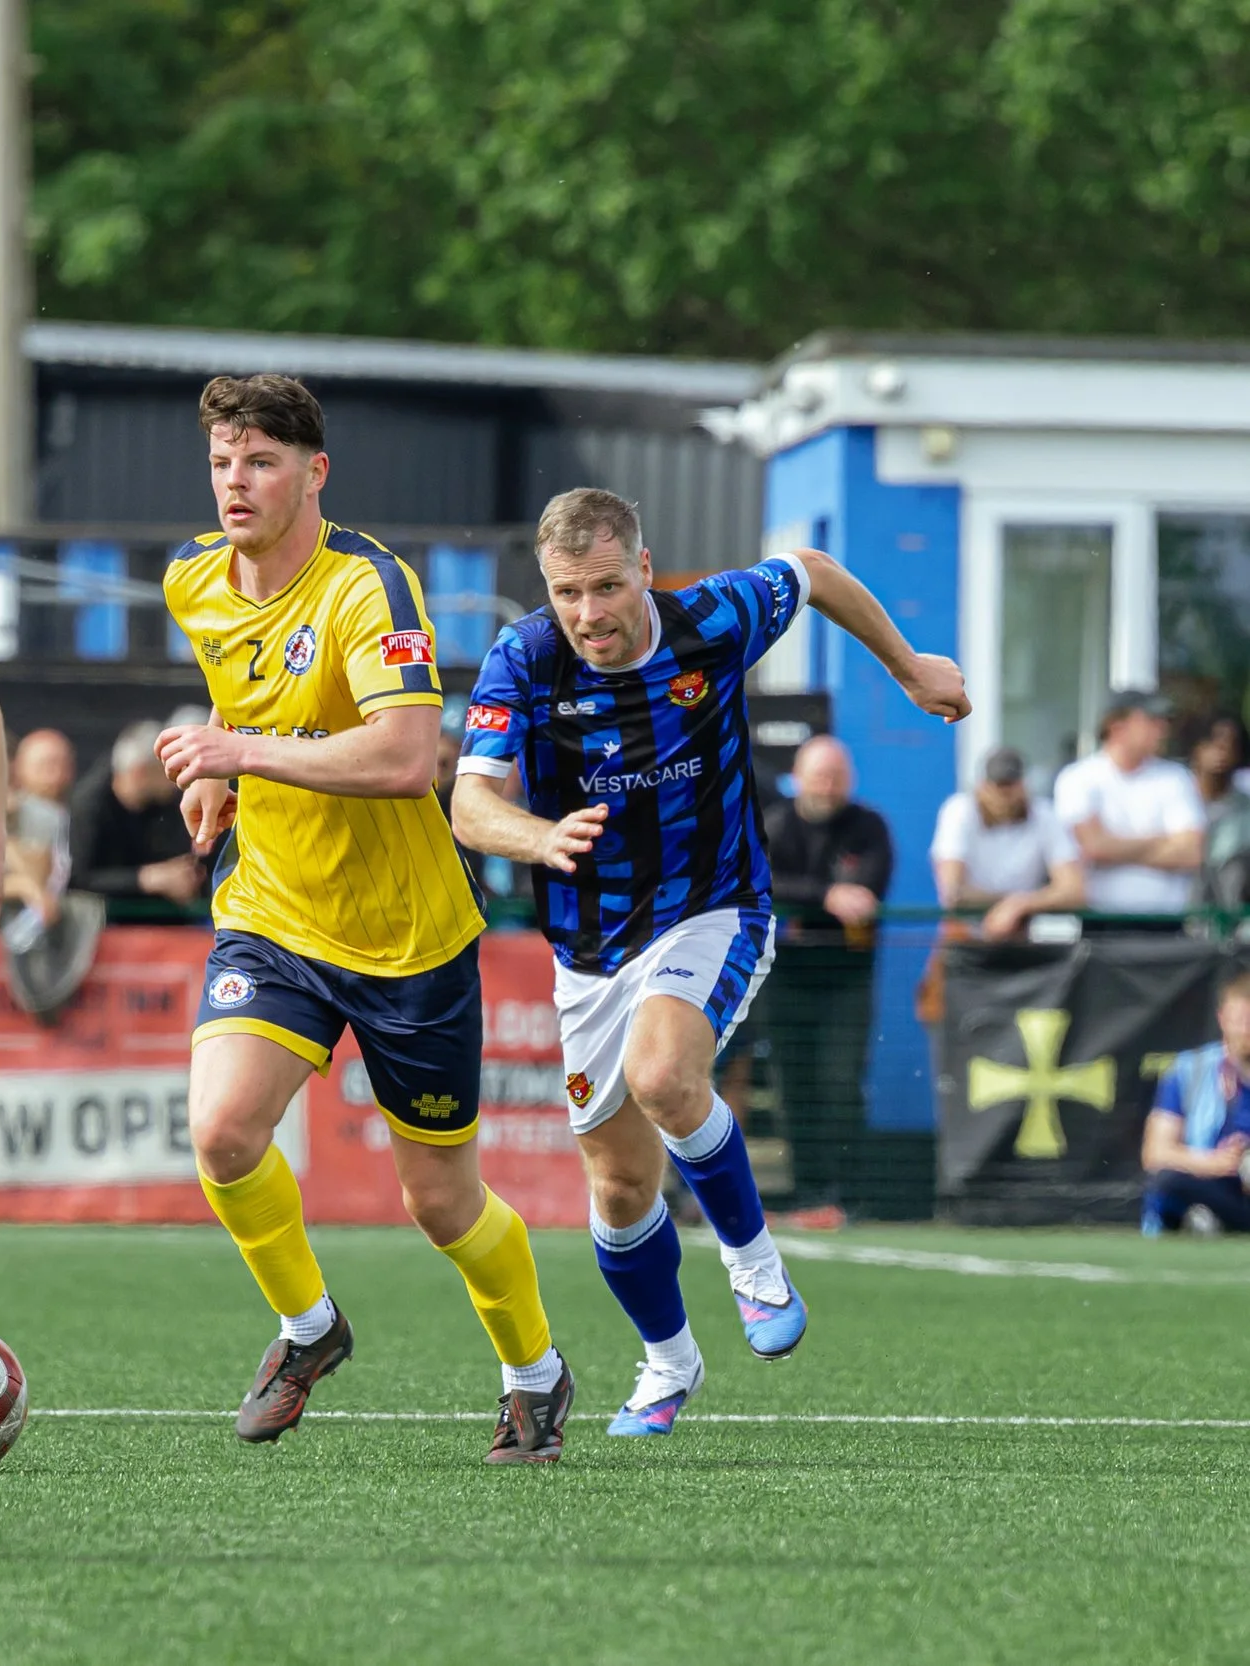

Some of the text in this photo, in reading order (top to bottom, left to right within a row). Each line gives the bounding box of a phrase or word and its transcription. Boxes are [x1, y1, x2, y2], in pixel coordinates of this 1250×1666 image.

[388, 633, 429, 651] PITCHING
[412, 647, 424, 661] IN
[578, 757, 703, 793] VESTACARE
[72, 1092, 192, 1154] OPE
